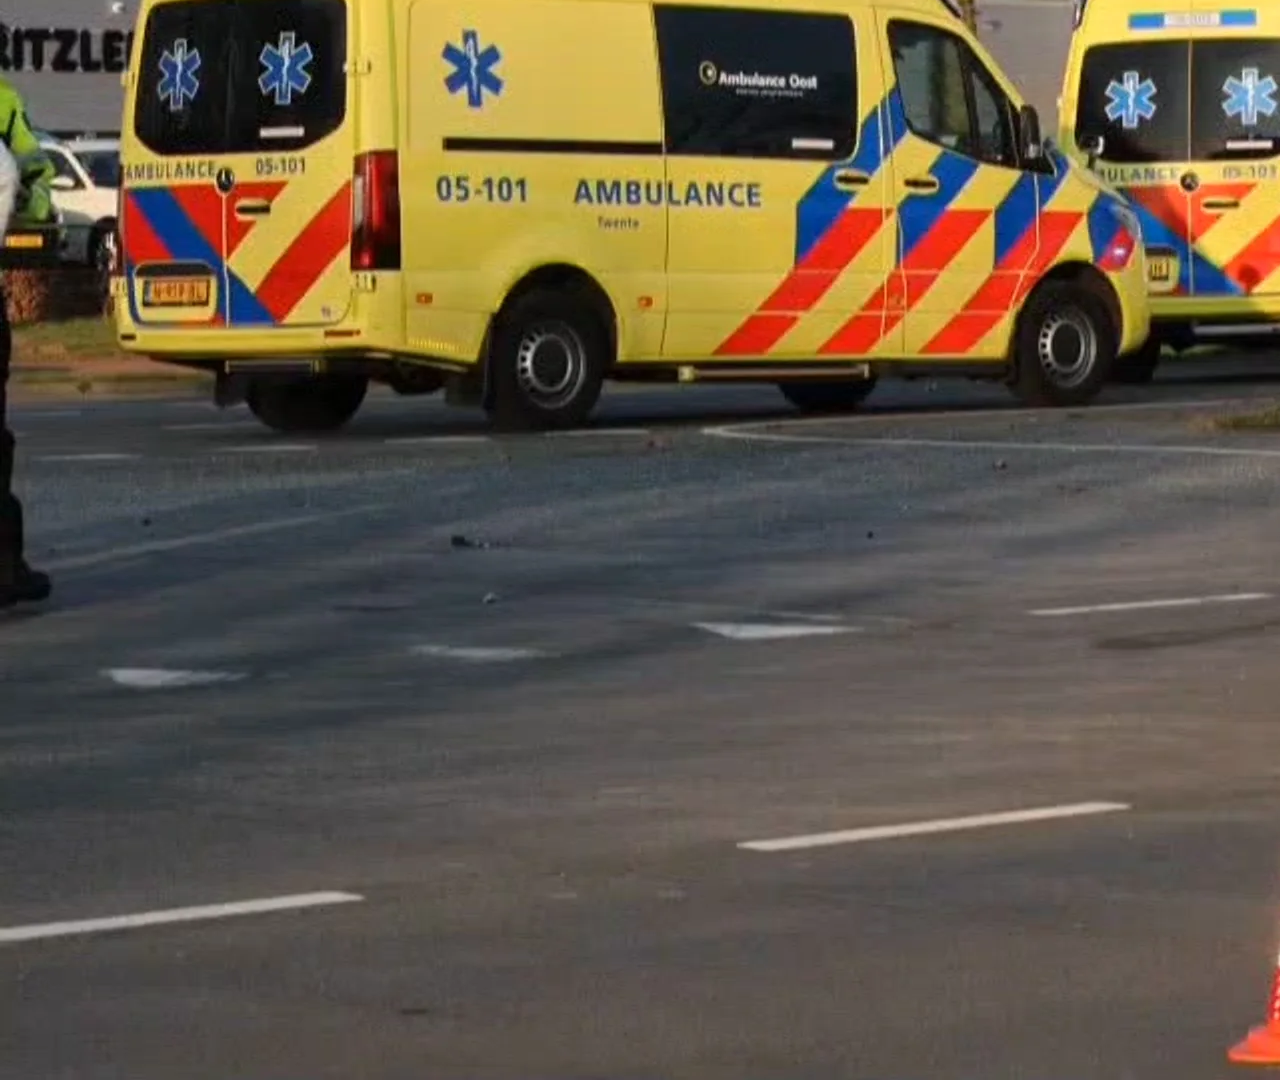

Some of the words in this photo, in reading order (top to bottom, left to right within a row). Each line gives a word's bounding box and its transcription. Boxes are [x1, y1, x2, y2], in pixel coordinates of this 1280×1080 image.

[719, 70, 786, 89] Ambulance
[789, 72, 818, 90] Oost
[126, 160, 216, 180] AMBULANCE
[255, 157, 307, 175] 05-101
[436, 175, 528, 203] 05-101
[573, 178, 762, 208] AMBULANCE
[596, 216, 640, 230] Twente
